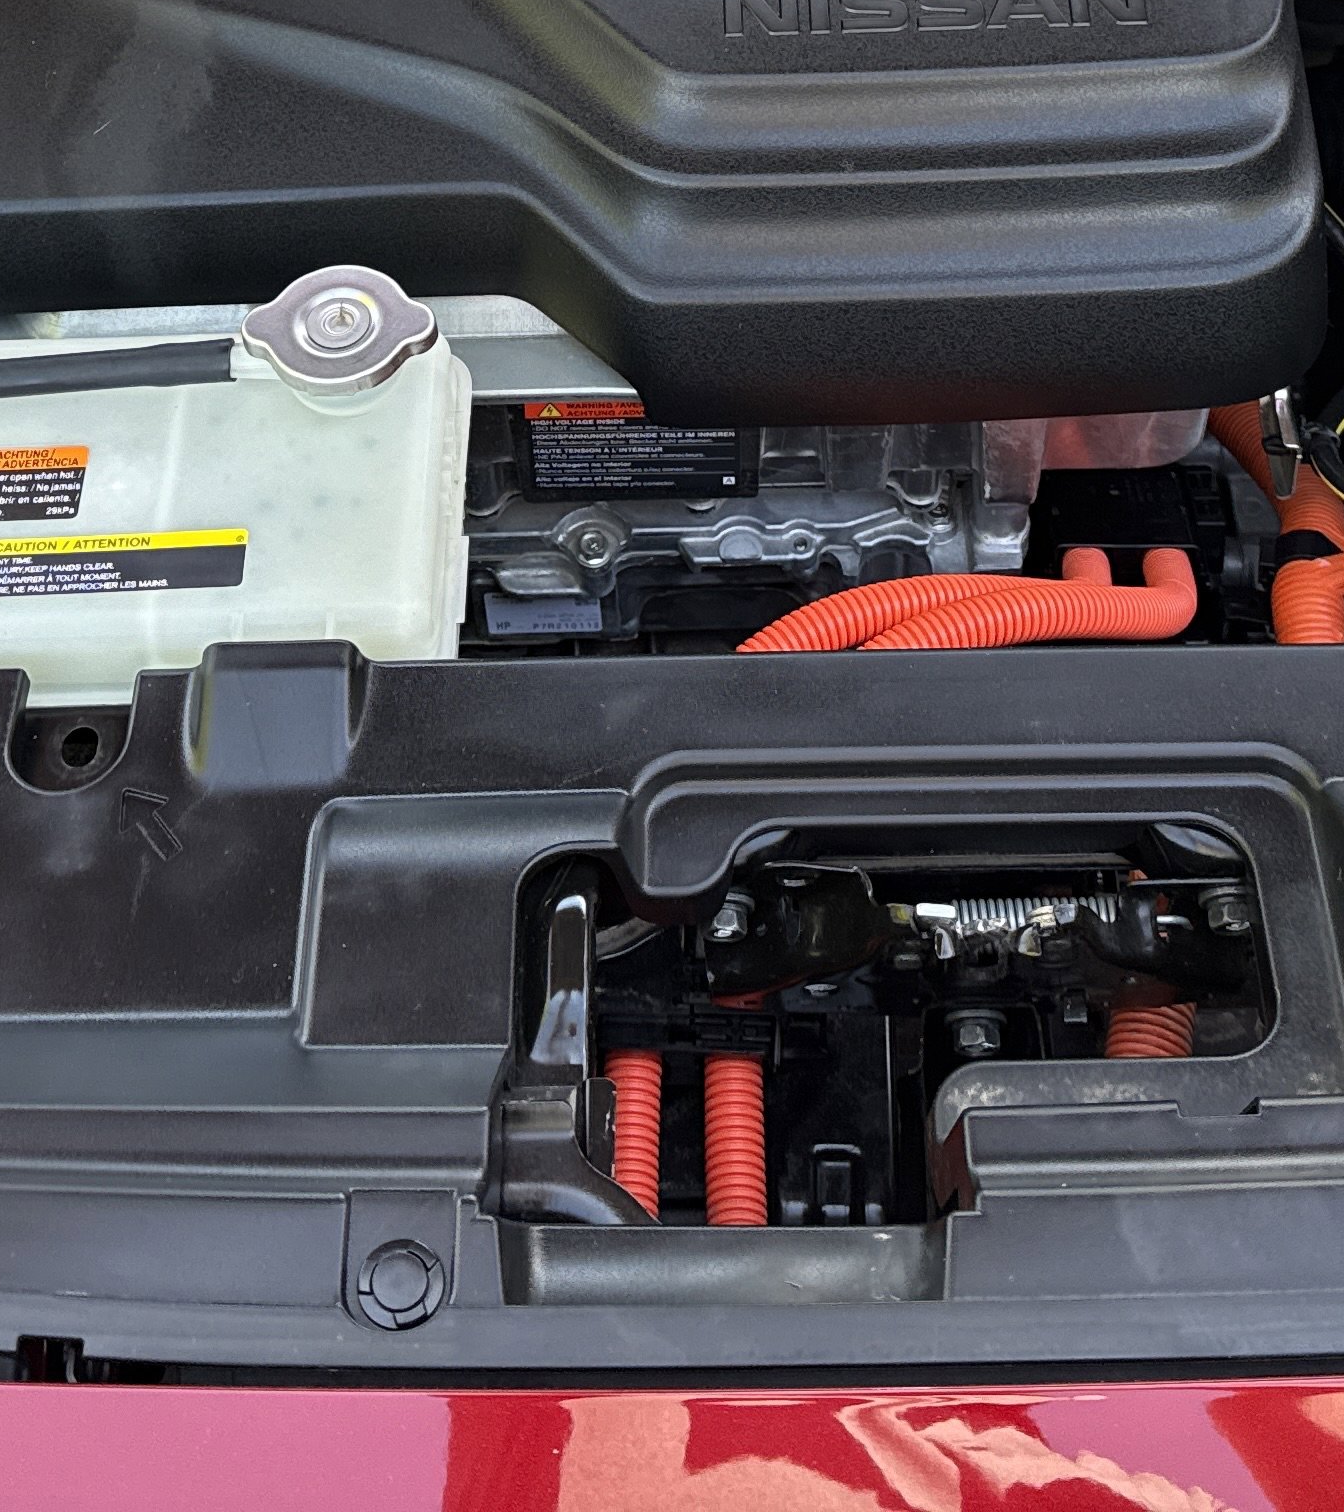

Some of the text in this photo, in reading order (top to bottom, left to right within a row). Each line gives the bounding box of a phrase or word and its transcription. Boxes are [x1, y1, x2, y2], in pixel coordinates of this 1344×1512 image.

[10, 474, 33, 483] open
[34, 471, 58, 481] when
[50, 482, 81, 493] jamais
[18, 496, 30, 504] en
[46, 507, 75, 516] 29kPa
[73, 537, 151, 550] ATTENTION
[49, 564, 81, 572] HANDS
[56, 574, 78, 582] TOUT
[47, 584, 59, 592] EN
[61, 581, 118, 591] APPROCHER
[120, 580, 137, 588] LES
